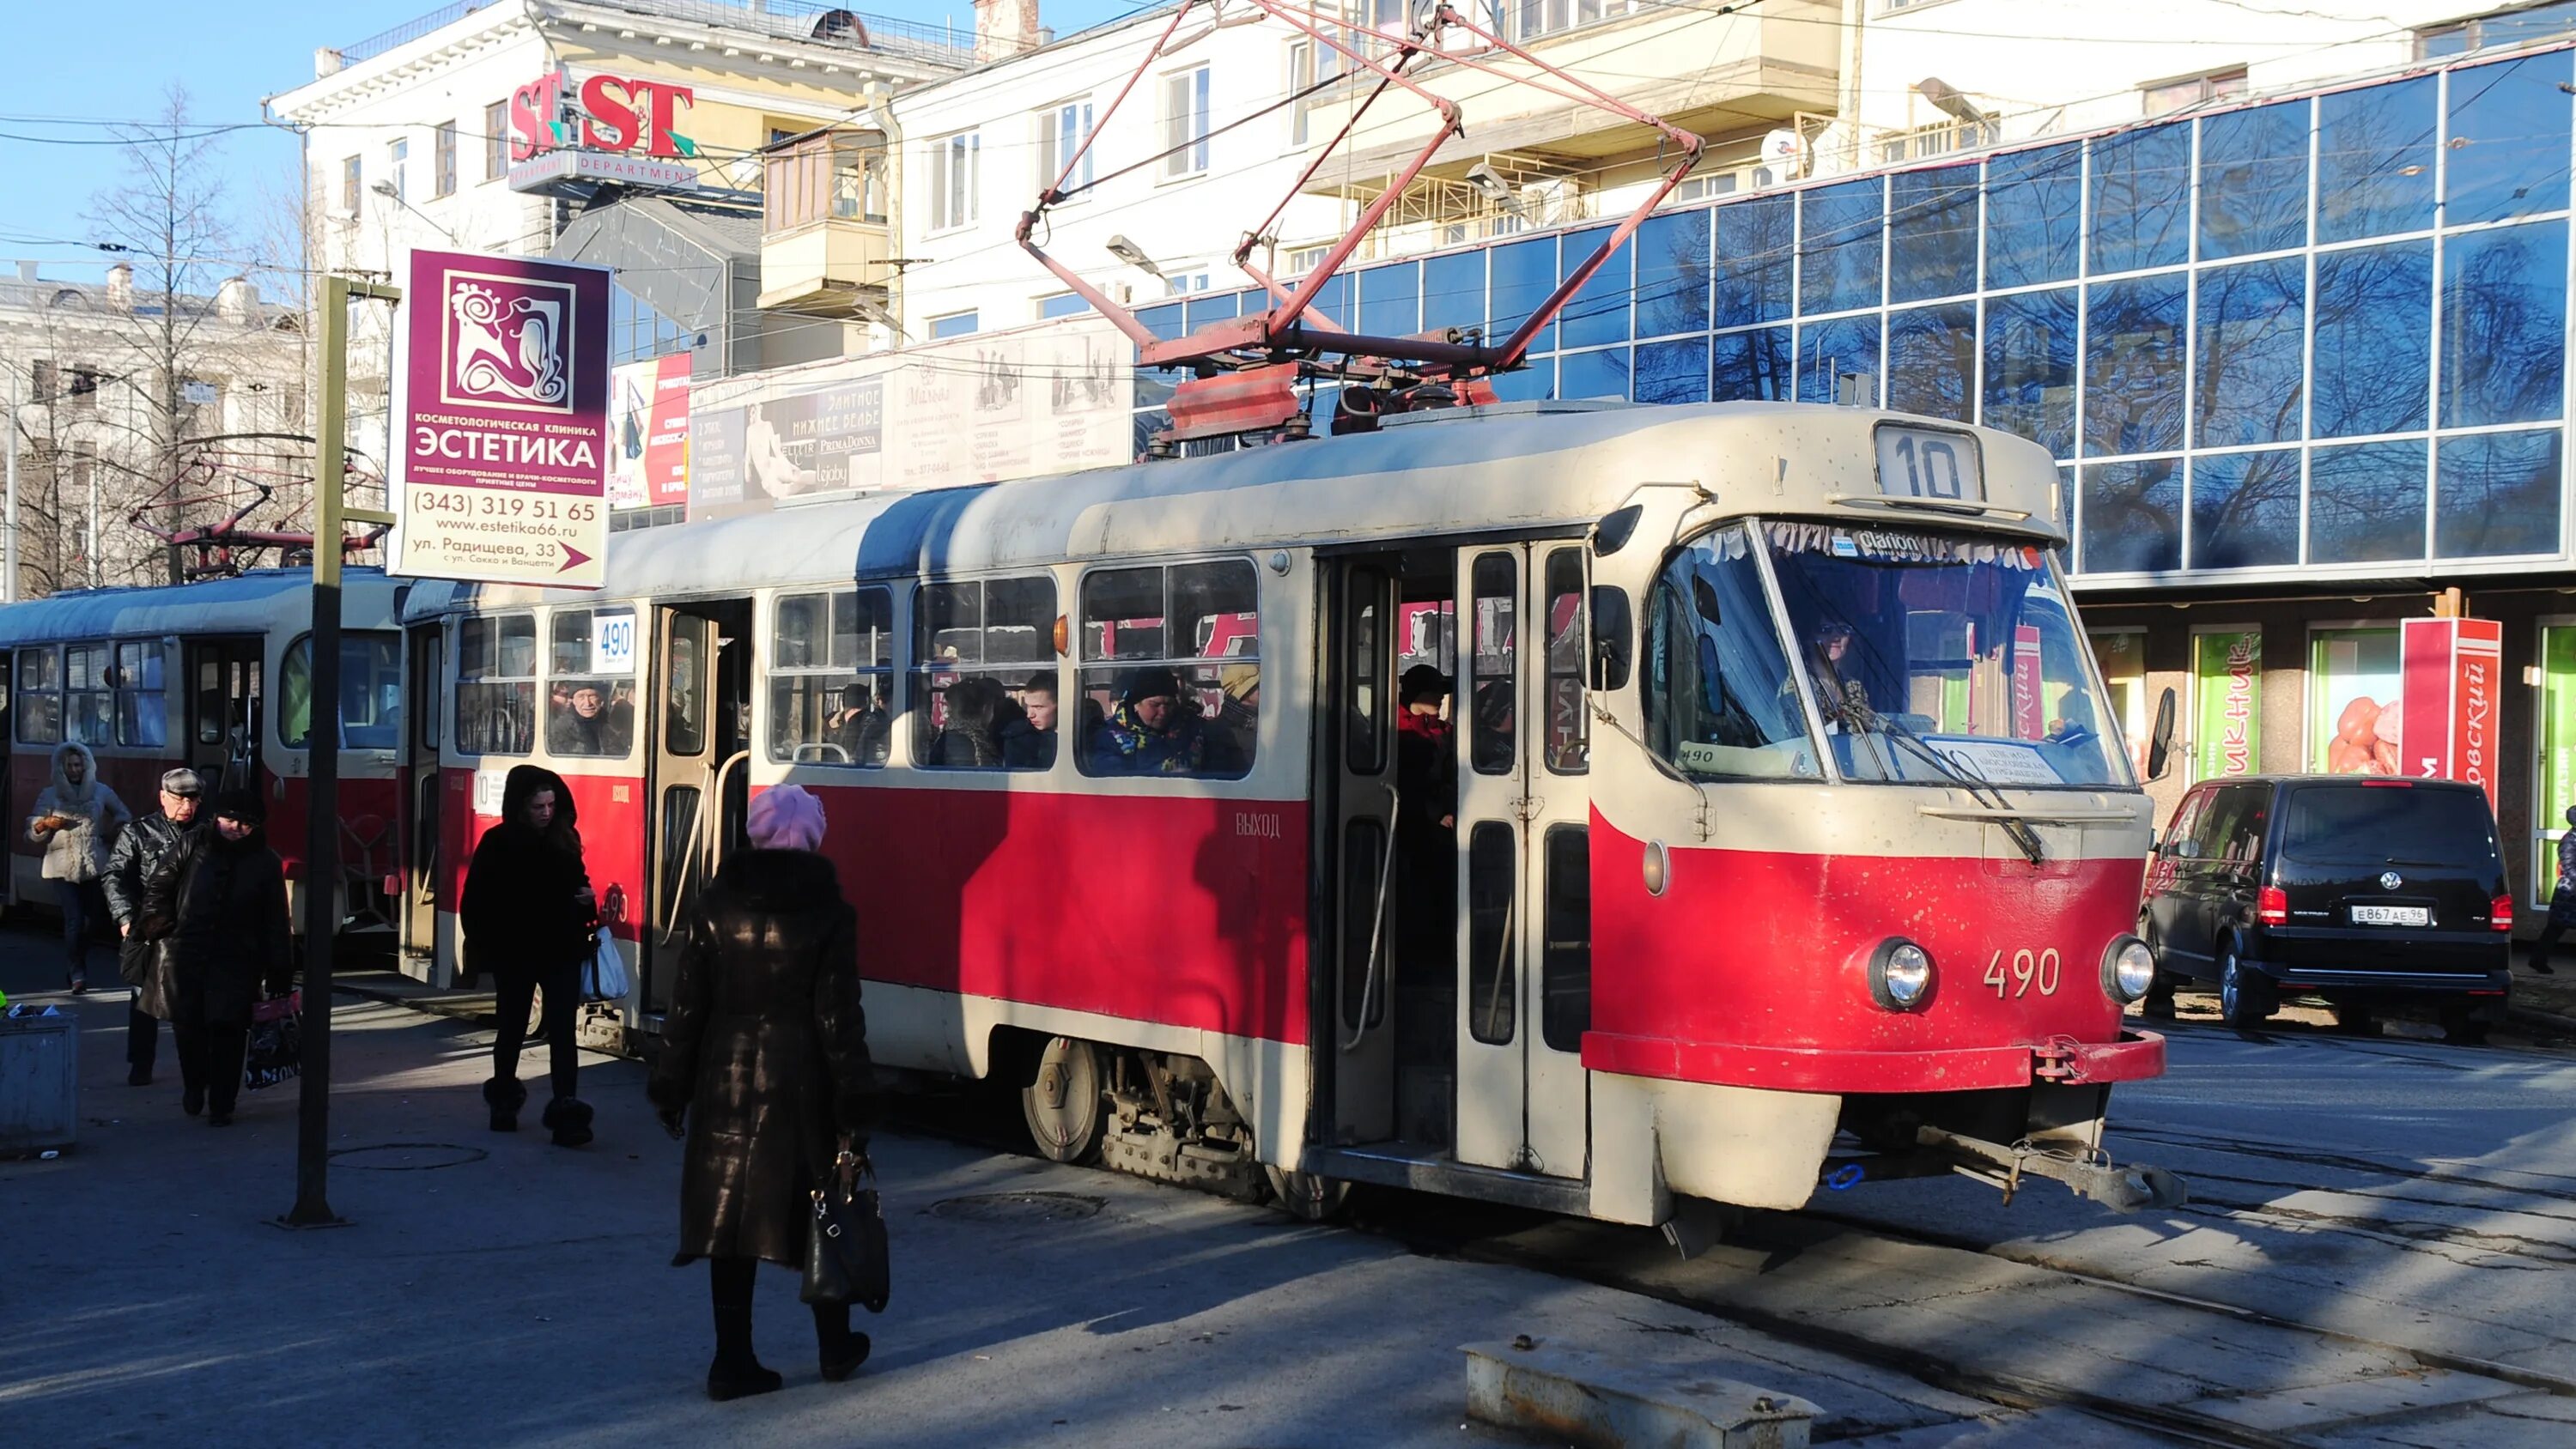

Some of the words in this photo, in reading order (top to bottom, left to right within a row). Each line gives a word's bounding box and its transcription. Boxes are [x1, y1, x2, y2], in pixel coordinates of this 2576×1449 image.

[580, 156, 693, 184] DEPARTMENT
[828, 391, 880, 411] ЭЛИТНОЕ
[415, 413, 540, 433] КОСМЕТОЛОГИЧЕСКАЯ
[544, 424, 598, 437] КЛИНИКА
[793, 415, 839, 436] НИЖНЕЕ
[843, 409, 880, 428] БЕЛЬЕ
[415, 427, 598, 469] ЭСТЕТИКА
[446, 468, 507, 480] ОБОРУДОВАНИЕ
[515, 473, 598, 486] ВРАЧИ-КОСМЕТОЛОГИ
[1896, 435, 1961, 500] 10
[414, 491, 472, 517] (343)
[481, 496, 525, 517] 319
[532, 500, 558, 519] 51
[568, 503, 596, 522] 65
[436, 518, 578, 537] www.estetika66.ru
[413, 539, 436, 553] ул.
[442, 537, 529, 557] Радищева,
[536, 543, 556, 558] 33
[511, 557, 556, 567] Ванцетти
[602, 622, 629, 656] 490
[2221, 635, 2252, 778] икник
[1682, 749, 1713, 762] 490
[1236, 812, 1280, 839] ВЫХОД
[2410, 909, 2423, 919] 96
[1984, 948, 2060, 998] 490
